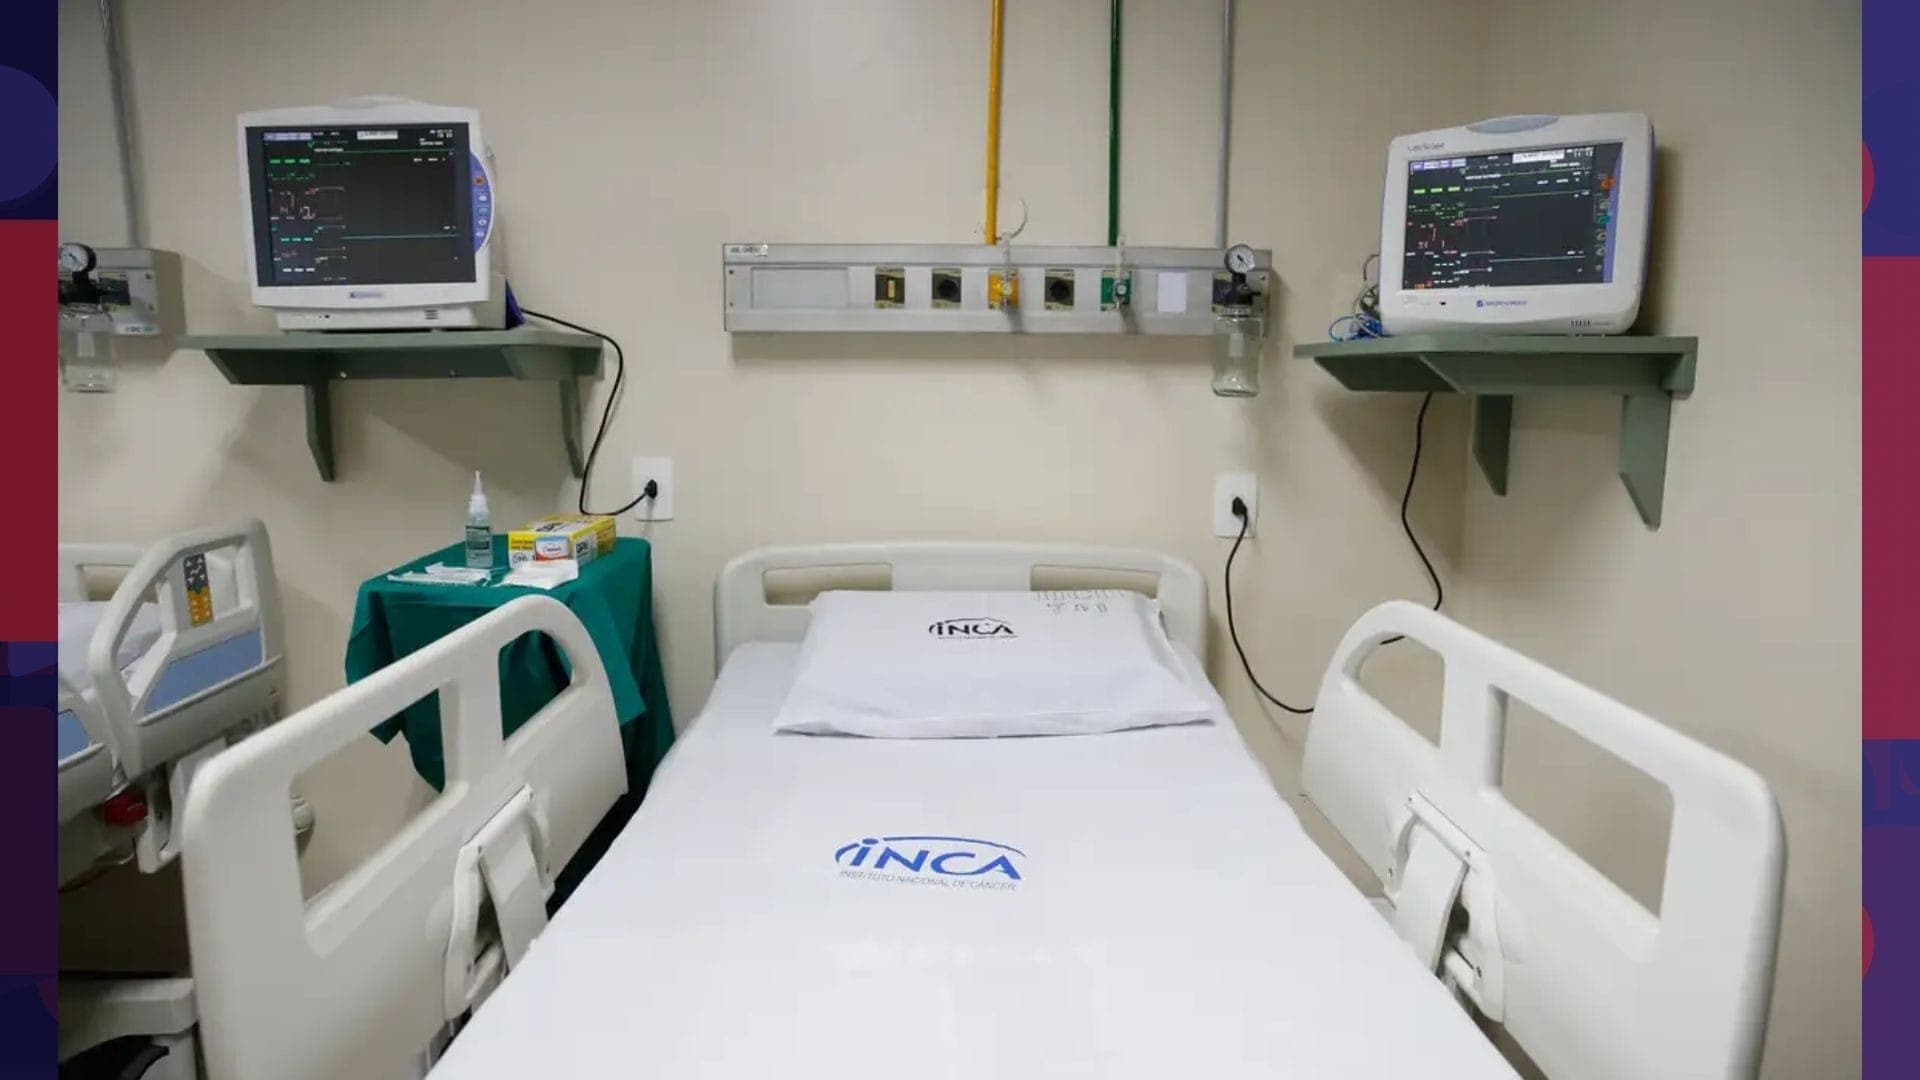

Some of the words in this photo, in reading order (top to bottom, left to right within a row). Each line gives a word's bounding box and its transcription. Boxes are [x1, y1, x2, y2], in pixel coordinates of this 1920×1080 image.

[839, 870, 894, 882] INSTITUTO
[896, 875, 949, 887] NACIONAL
[951, 880, 969, 888] DE
